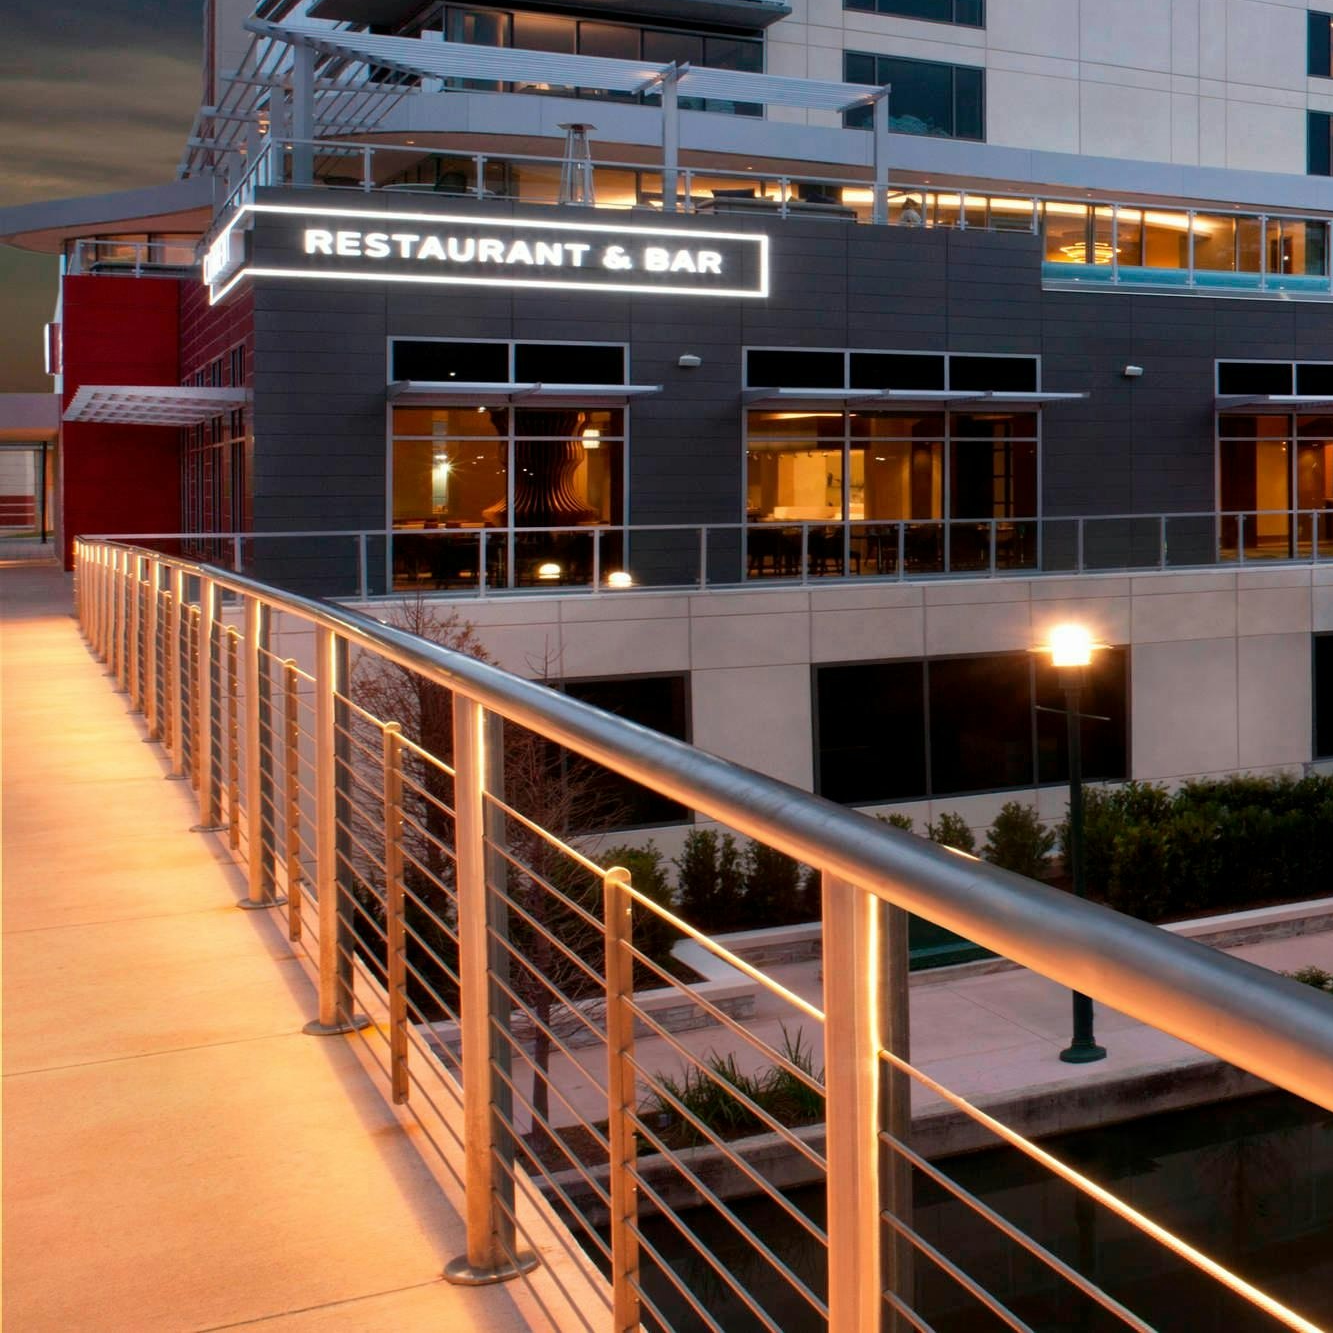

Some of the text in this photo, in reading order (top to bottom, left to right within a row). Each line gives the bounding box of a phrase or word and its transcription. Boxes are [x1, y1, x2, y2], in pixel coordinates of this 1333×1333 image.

[304, 228, 722, 274] RESTAURANT & BAR
